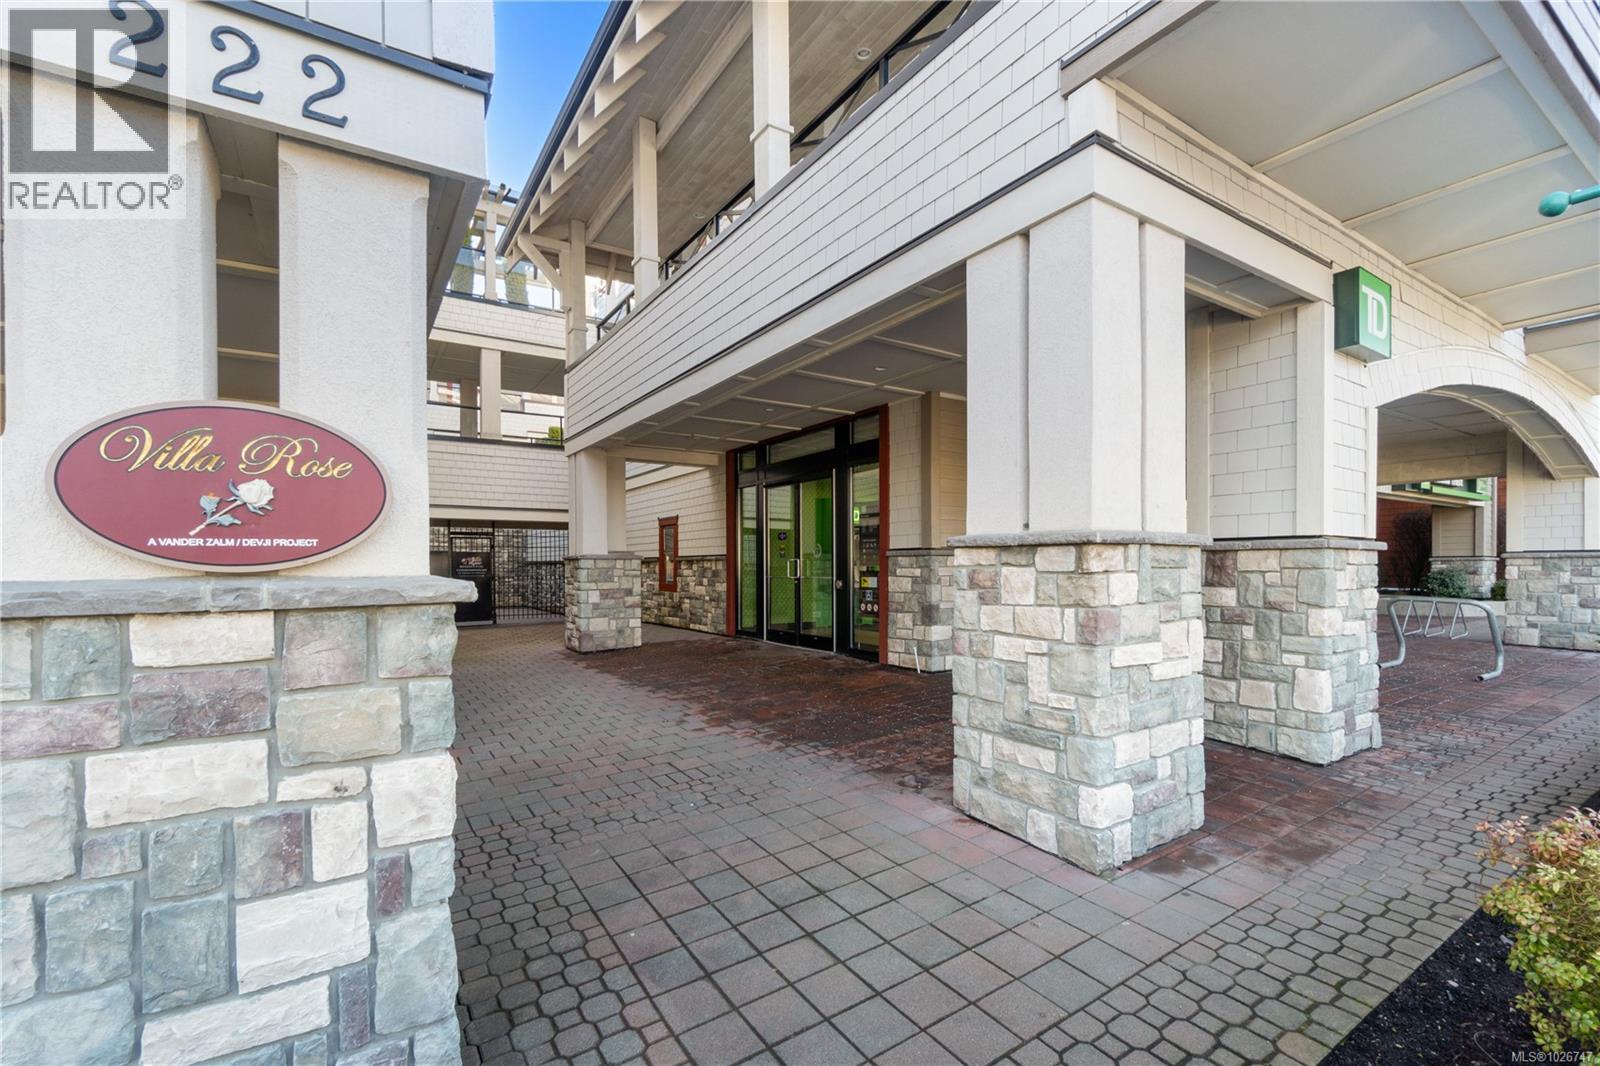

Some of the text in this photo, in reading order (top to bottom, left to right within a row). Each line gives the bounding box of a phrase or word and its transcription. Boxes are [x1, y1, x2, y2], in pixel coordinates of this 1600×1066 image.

[109, 0, 348, 128] 222
[1361, 284, 1388, 339] TD
[100, 425, 353, 478] Villa Rose
[147, 538, 157, 547] A
[158, 538, 204, 547] VANDER
[205, 538, 235, 547] ZALM
[242, 538, 271, 547] DEVJI
[273, 538, 319, 547] PROJECT
